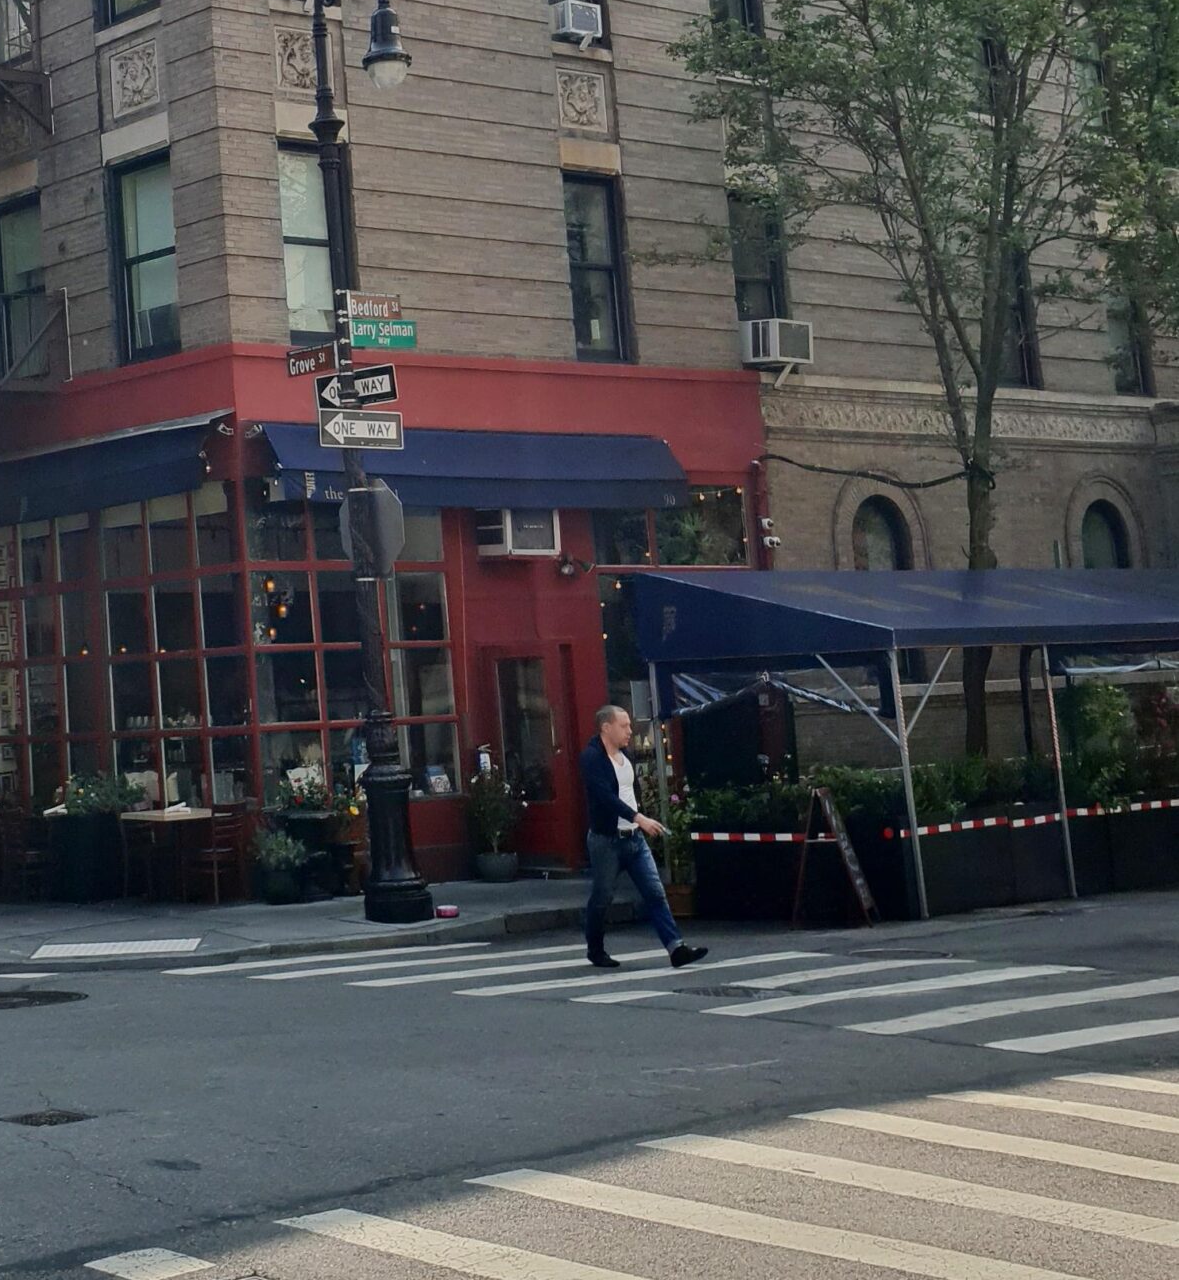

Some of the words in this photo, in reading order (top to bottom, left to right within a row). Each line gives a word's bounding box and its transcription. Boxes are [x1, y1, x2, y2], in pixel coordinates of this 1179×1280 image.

[351, 299, 389, 317] Bedford
[391, 301, 399, 312] St
[353, 321, 376, 340] Larry
[378, 321, 414, 337] Selman
[378, 336, 391, 346] Way
[289, 358, 316, 375] Grove
[318, 352, 325, 363] St
[361, 377, 385, 394] WAY
[333, 421, 356, 435] ONE
[367, 422, 391, 437] WAY
[324, 485, 344, 500] the
